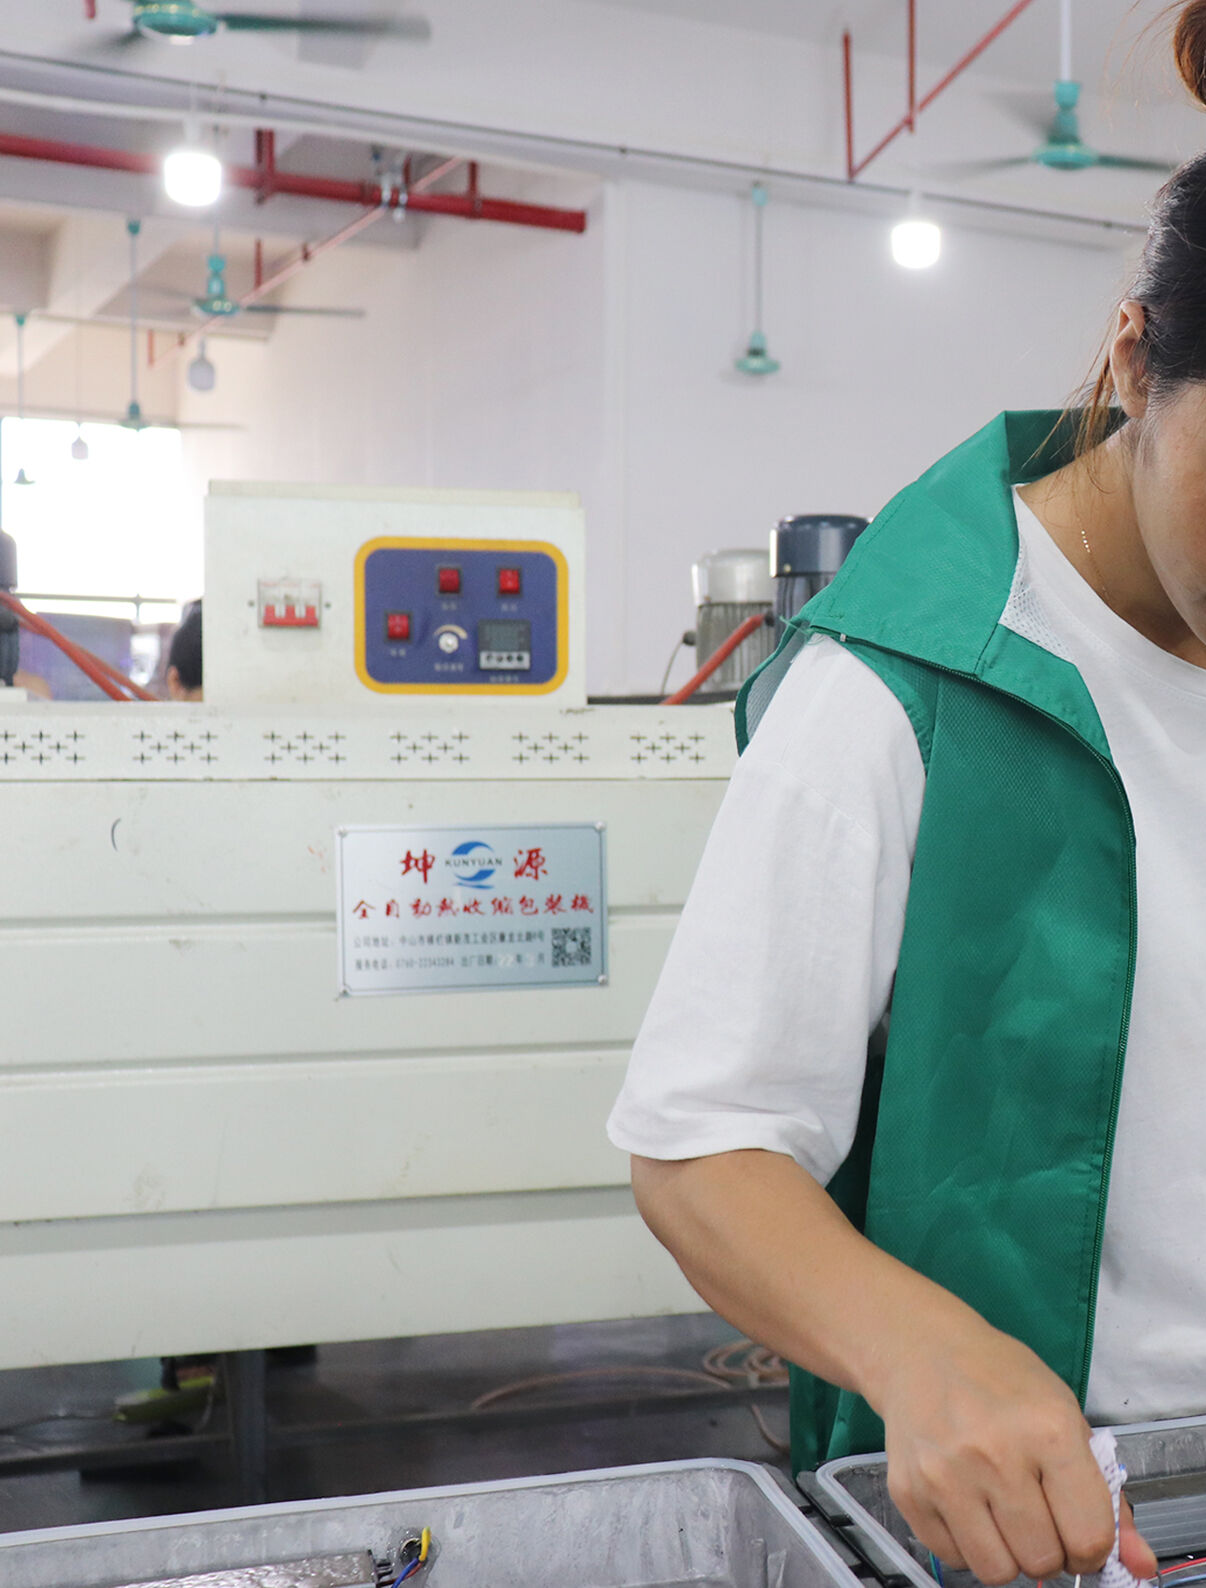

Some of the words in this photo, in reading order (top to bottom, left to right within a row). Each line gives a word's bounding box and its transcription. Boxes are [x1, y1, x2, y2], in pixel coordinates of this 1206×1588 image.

[400, 848, 436, 884] 坤
[444, 858, 503, 867] KUNYUAN
[513, 847, 548, 881] 源
